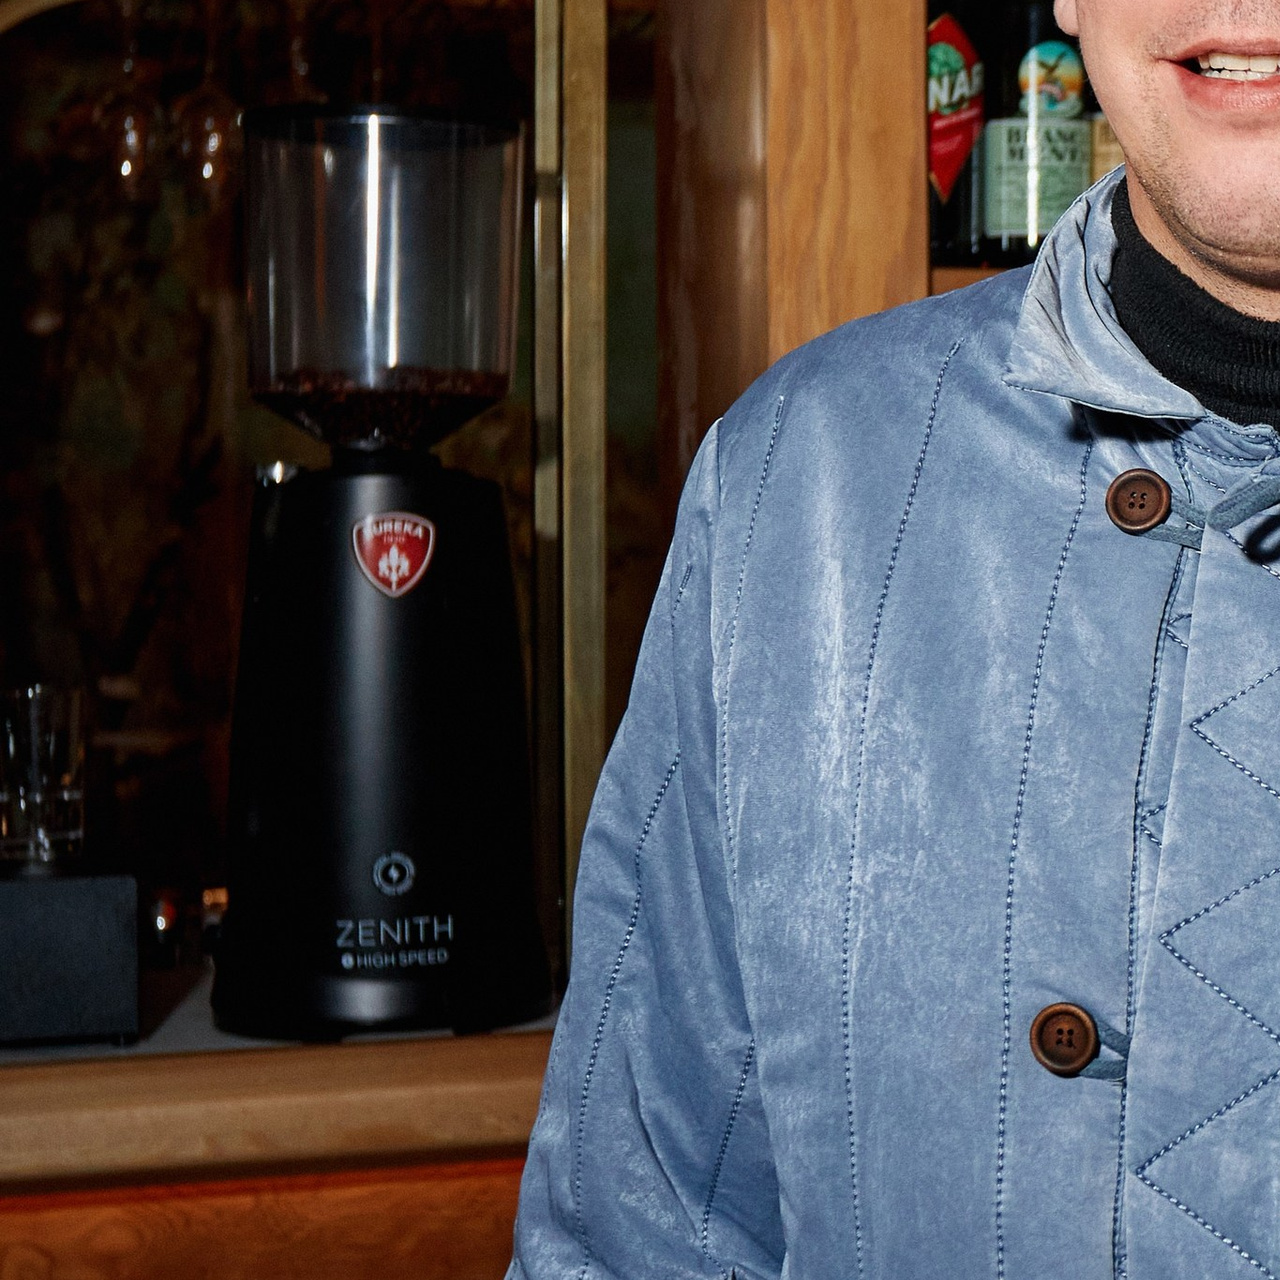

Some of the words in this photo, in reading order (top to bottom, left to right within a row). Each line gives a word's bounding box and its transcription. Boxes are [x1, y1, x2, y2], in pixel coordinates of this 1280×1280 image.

[336, 914, 455, 948] ZENITH
[356, 951, 396, 969] HIGH
[398, 947, 450, 968] SPEED
